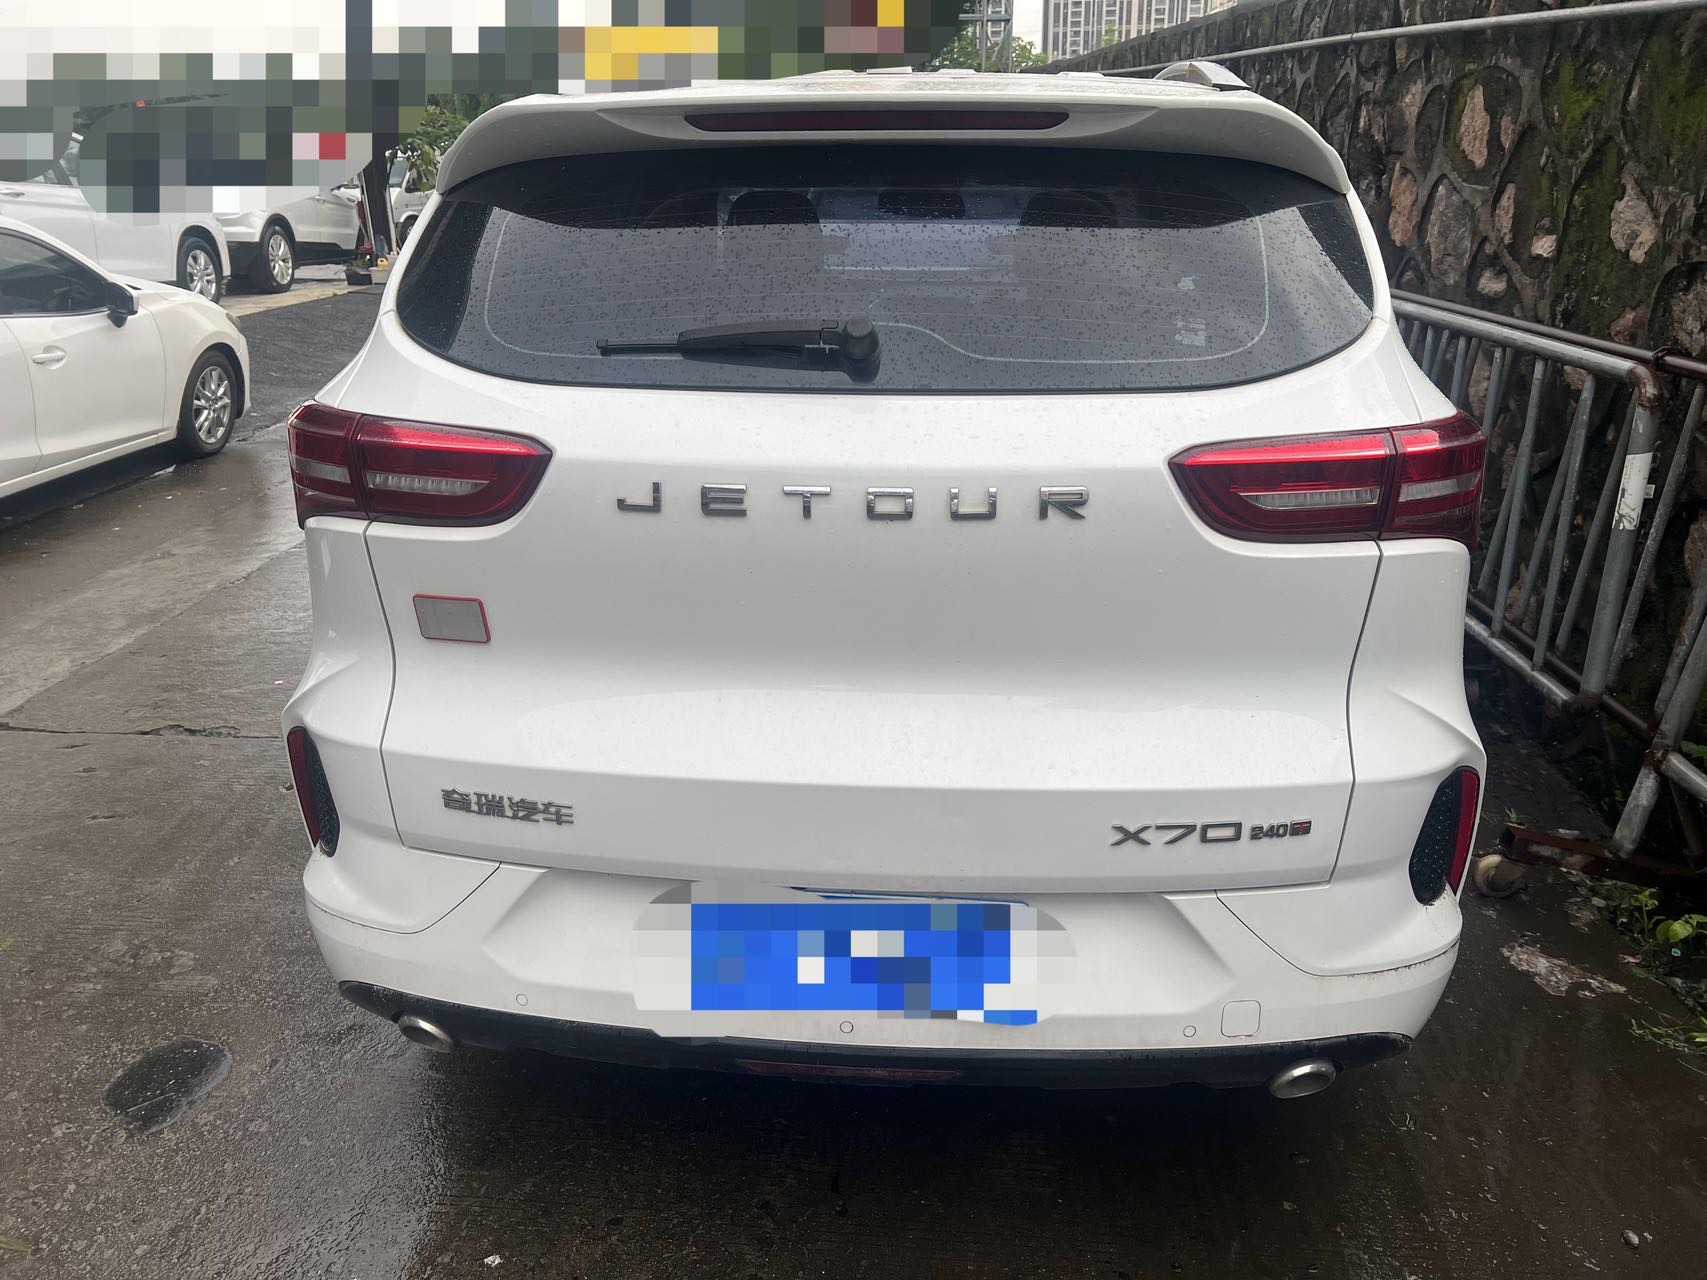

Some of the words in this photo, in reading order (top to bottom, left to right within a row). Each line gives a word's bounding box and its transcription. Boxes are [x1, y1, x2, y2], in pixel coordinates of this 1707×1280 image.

[616, 480, 1090, 521] JETOUR
[441, 788, 574, 826] 奇瑞汽车
[1110, 820, 1243, 847] X70
